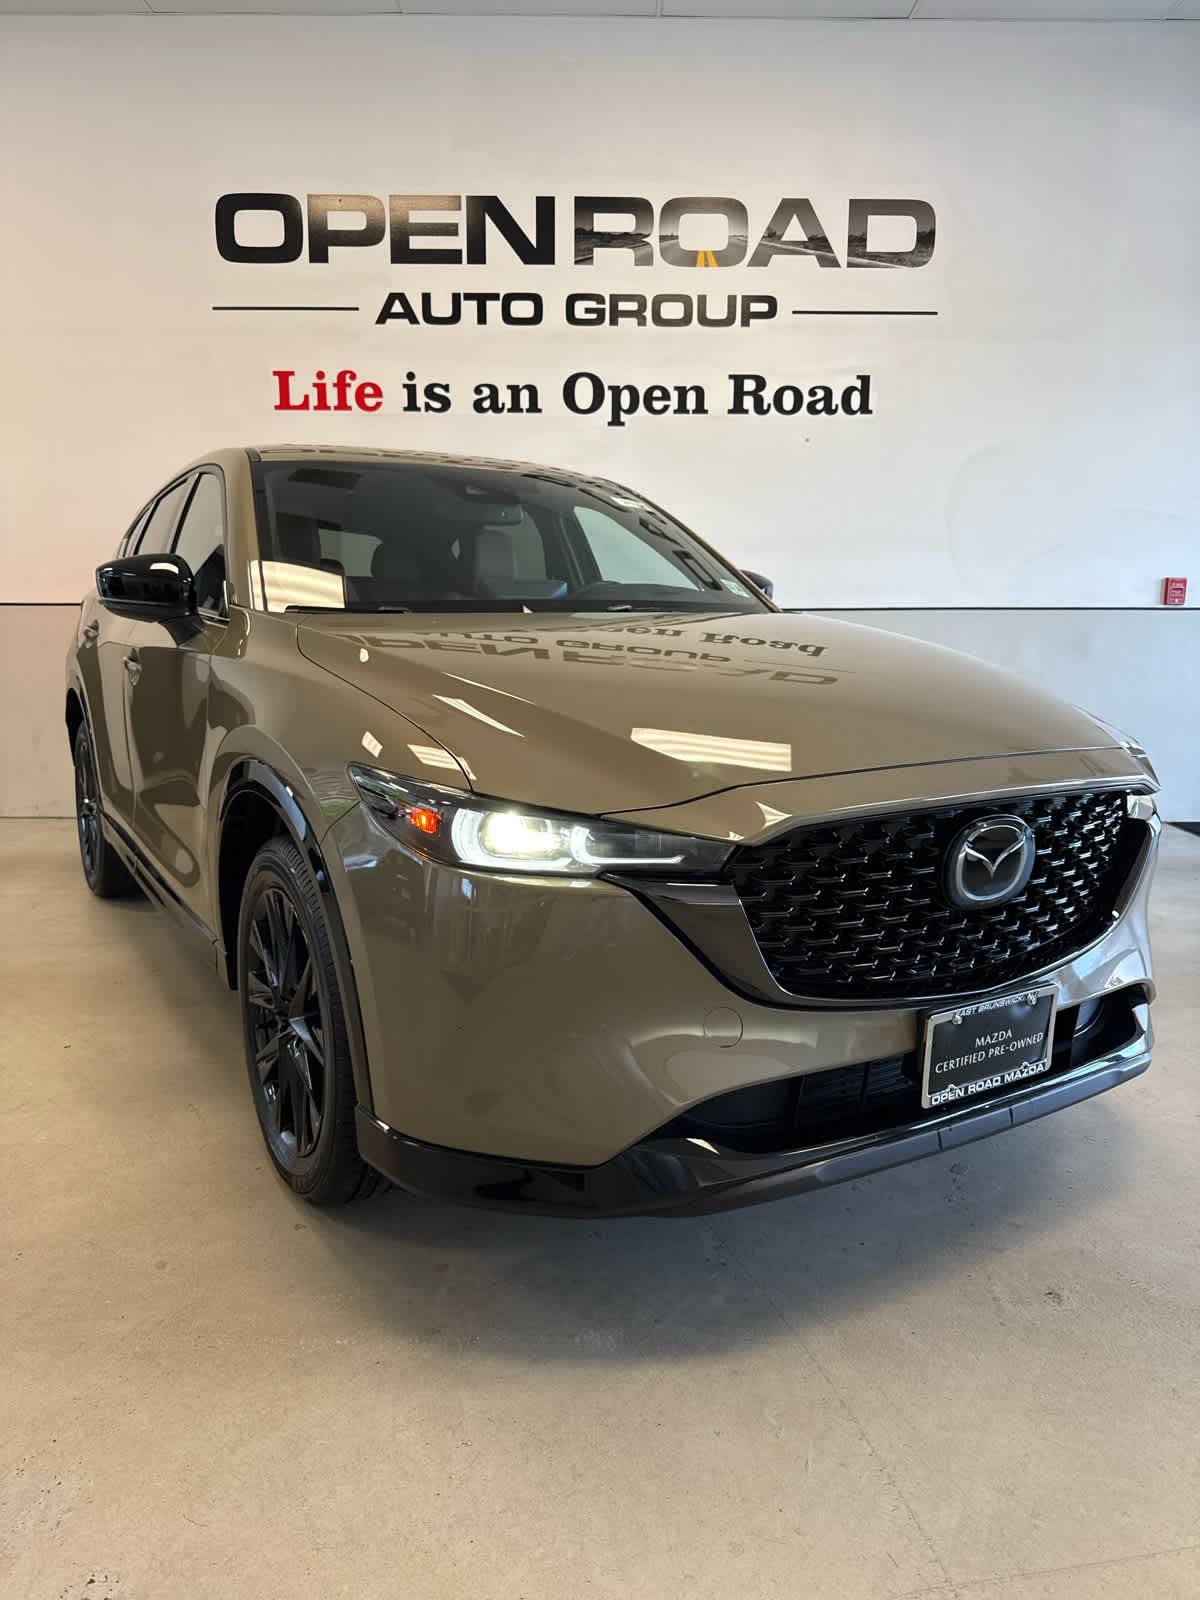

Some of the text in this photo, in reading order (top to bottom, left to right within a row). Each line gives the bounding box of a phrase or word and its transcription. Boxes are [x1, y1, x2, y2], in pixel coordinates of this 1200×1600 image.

[213, 193, 937, 269] OPEN ROAD
[375, 292, 778, 328] AUTO GROUP
[272, 369, 873, 427] Life is an Open Road
[935, 1032, 1044, 1074] CERTIFIED PRE-OWNED
[975, 1028, 1013, 1048] MAZDA
[931, 1063, 1044, 1106] OPEN ROAD MAZDA
